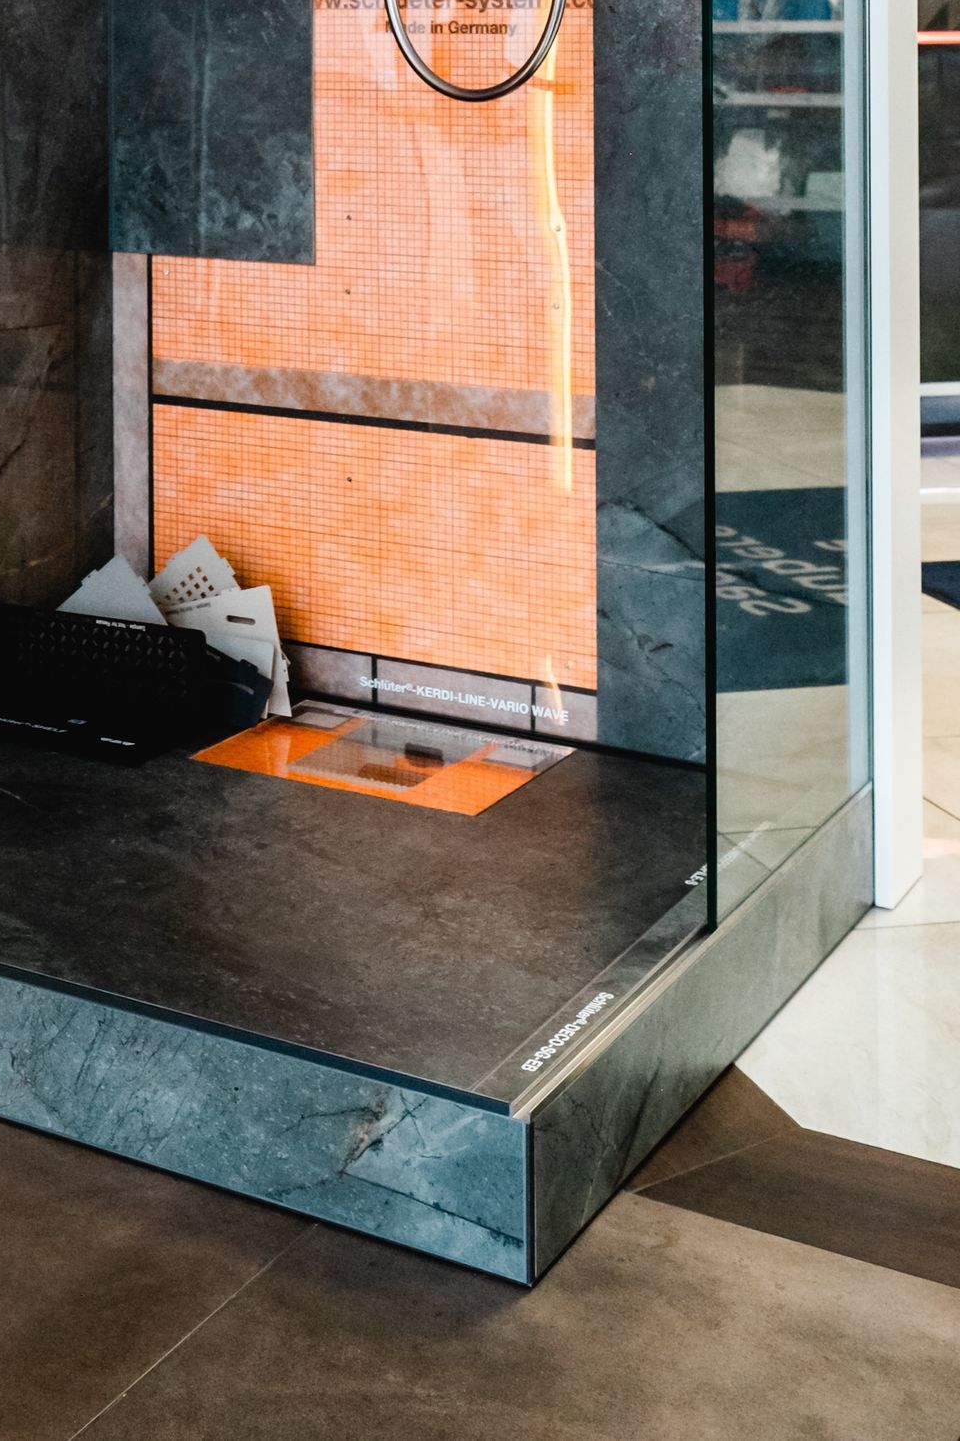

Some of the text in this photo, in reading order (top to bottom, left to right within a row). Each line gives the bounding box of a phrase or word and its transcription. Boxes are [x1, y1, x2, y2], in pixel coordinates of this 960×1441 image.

[430, 20, 441, 34] in
[448, 21, 517, 37] Germany
[359, 676, 569, 722] Schlüter®-KERDI-LINE-VARIO WAVE
